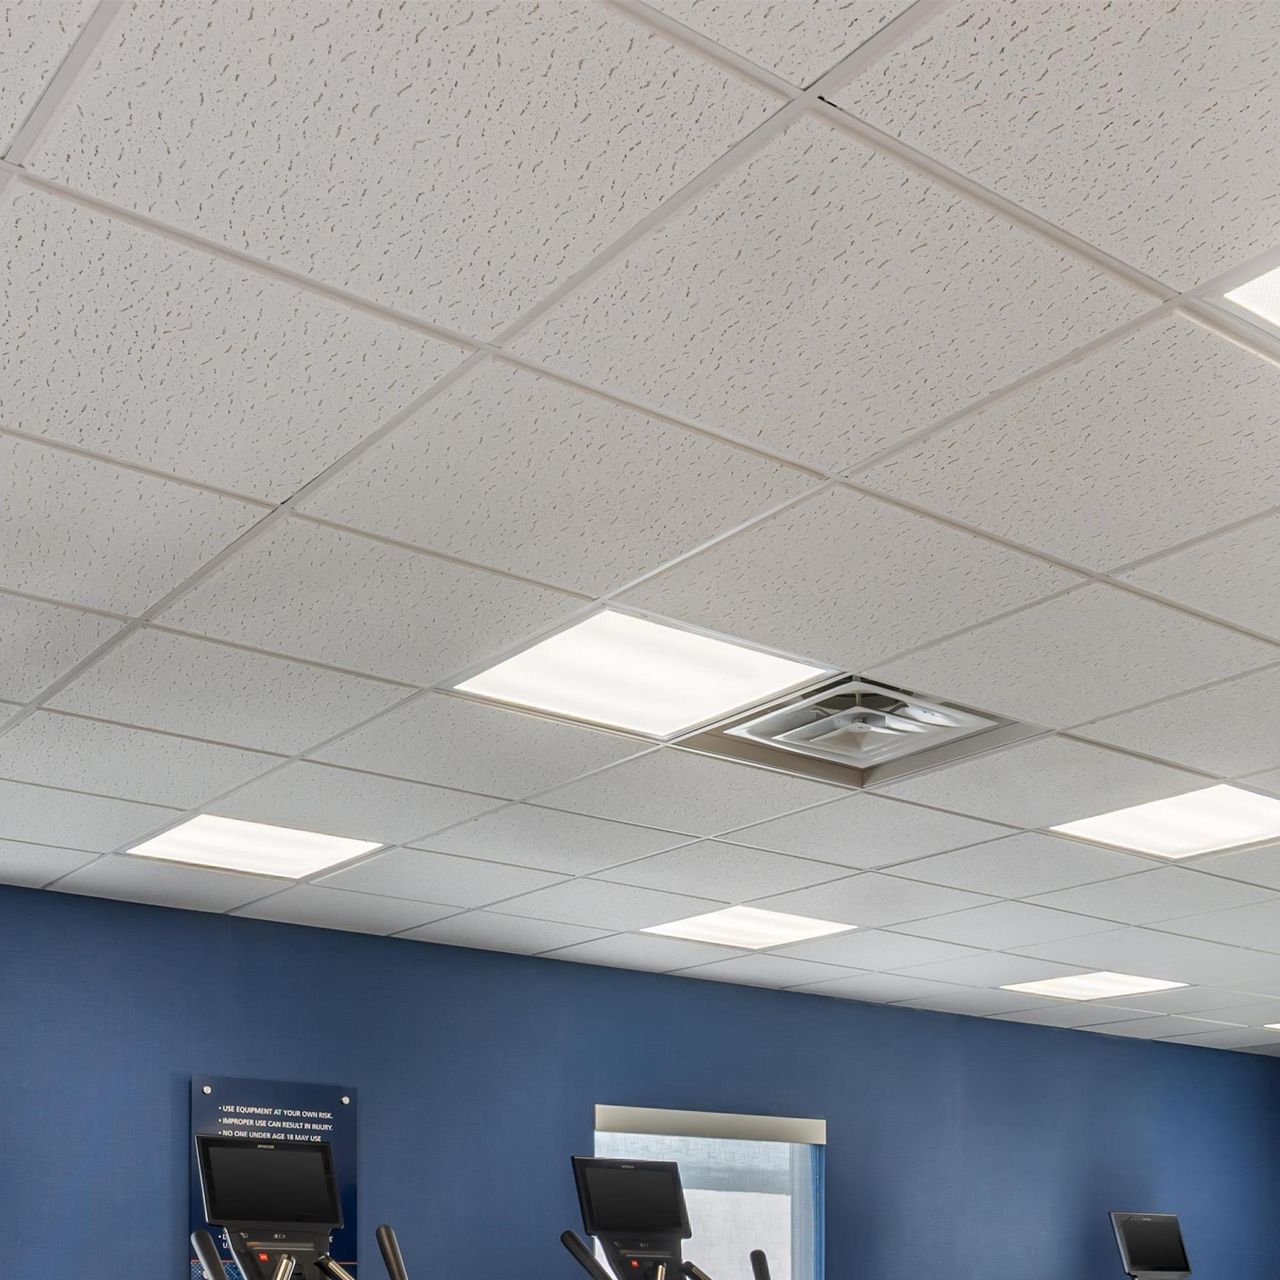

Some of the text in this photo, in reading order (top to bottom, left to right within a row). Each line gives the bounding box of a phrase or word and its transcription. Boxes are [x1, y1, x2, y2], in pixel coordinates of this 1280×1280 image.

[236, 1106, 272, 1115] EQUIPMENT
[283, 1109, 301, 1117] YOUR
[222, 1118, 254, 1126] IMPROPER
[282, 1121, 303, 1129] RESULT
[311, 1123, 333, 1131] INJURY.
[249, 1131, 271, 1139] UNDER
[272, 1132, 285, 1140] AGE
